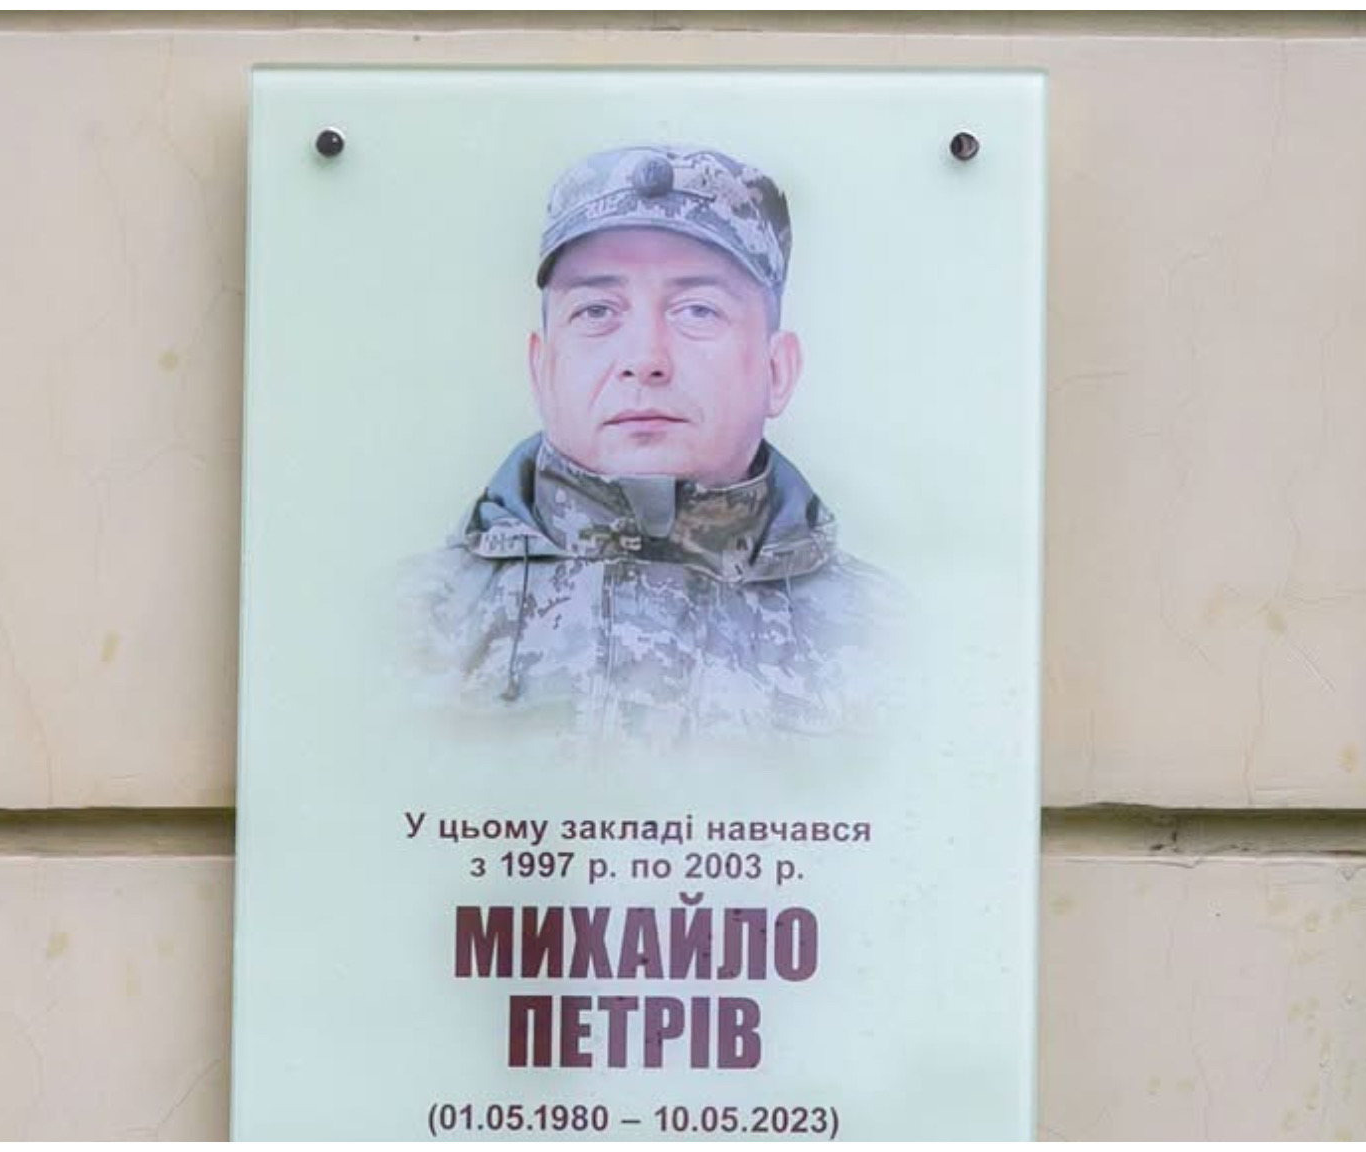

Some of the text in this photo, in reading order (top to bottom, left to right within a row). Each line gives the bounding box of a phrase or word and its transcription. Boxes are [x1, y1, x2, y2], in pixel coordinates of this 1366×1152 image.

[404, 811, 871, 847] У цьому закладі навчався
[469, 851, 804, 887] з 1997 р. по 2003 р.
[454, 891, 818, 982] МИХАЙЛО
[507, 994, 762, 1069] ПЕТРІВ
[428, 1103, 609, 1137] (01.05.1980
[654, 1105, 839, 1140] 10.05.2023)
